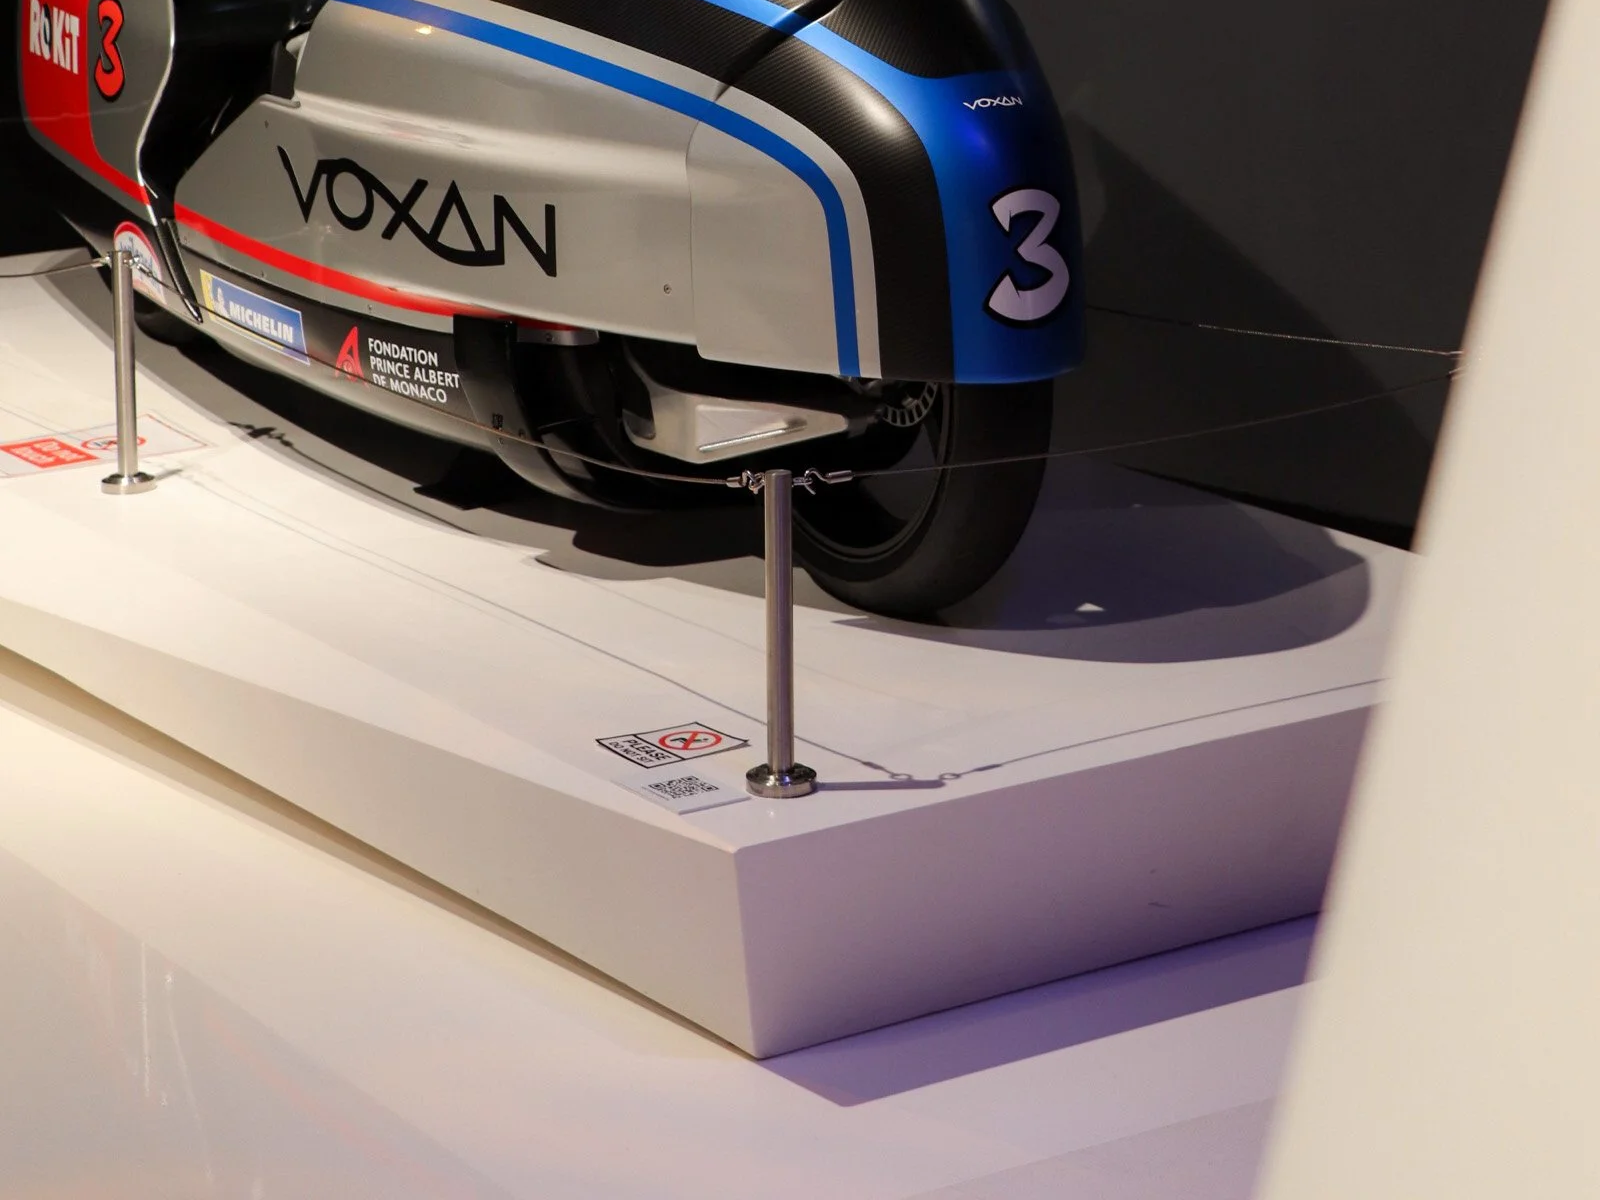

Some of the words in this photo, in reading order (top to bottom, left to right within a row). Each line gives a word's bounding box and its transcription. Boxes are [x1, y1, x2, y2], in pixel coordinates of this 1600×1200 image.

[963, 96, 1023, 110] VOXAN
[277, 145, 557, 277] VOXAN
[986, 187, 1070, 326] 3
[229, 301, 294, 343] MICHELIN
[368, 338, 438, 367] FONDATION
[369, 356, 411, 378] PRINCE
[414, 364, 460, 388] ALBERT
[372, 373, 388, 388] DE
[389, 380, 447, 403] MONACO
[622, 740, 672, 760] PLEASE
